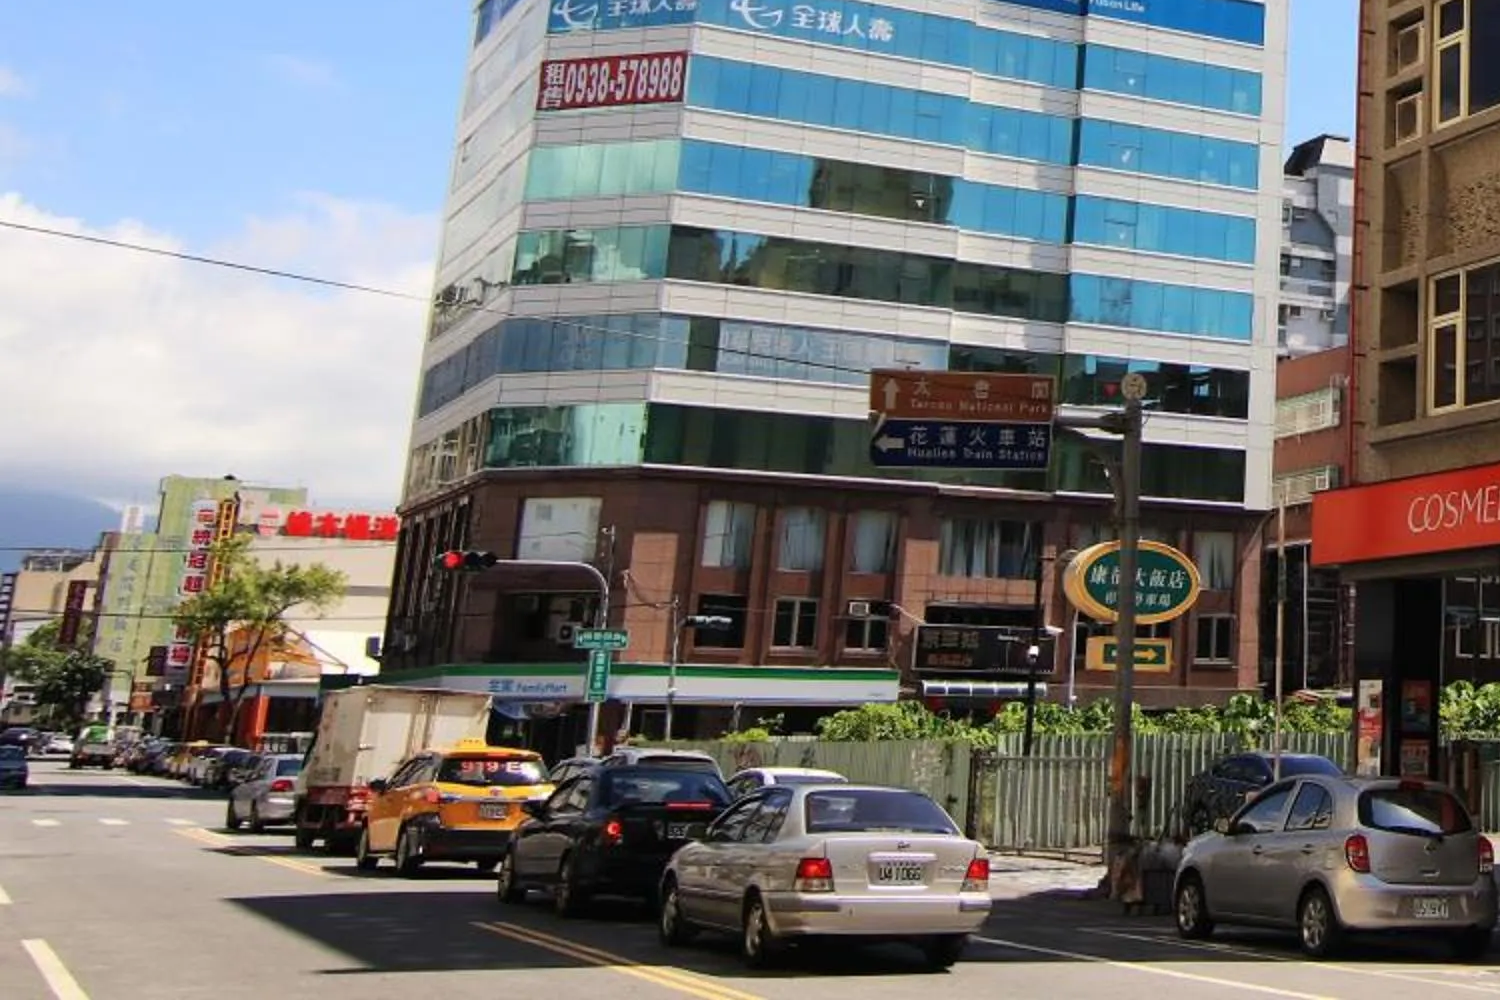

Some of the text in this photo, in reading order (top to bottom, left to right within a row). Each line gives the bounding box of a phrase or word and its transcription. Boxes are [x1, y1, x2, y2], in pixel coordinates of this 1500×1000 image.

[791, 5, 894, 42] 全球人壽
[913, 377, 1050, 400] 太魯閣
[959, 400, 1014, 413] National
[1019, 402, 1048, 414] Park
[909, 426, 1046, 449] 花蓮火車站
[1000, 449, 1045, 462] Station
